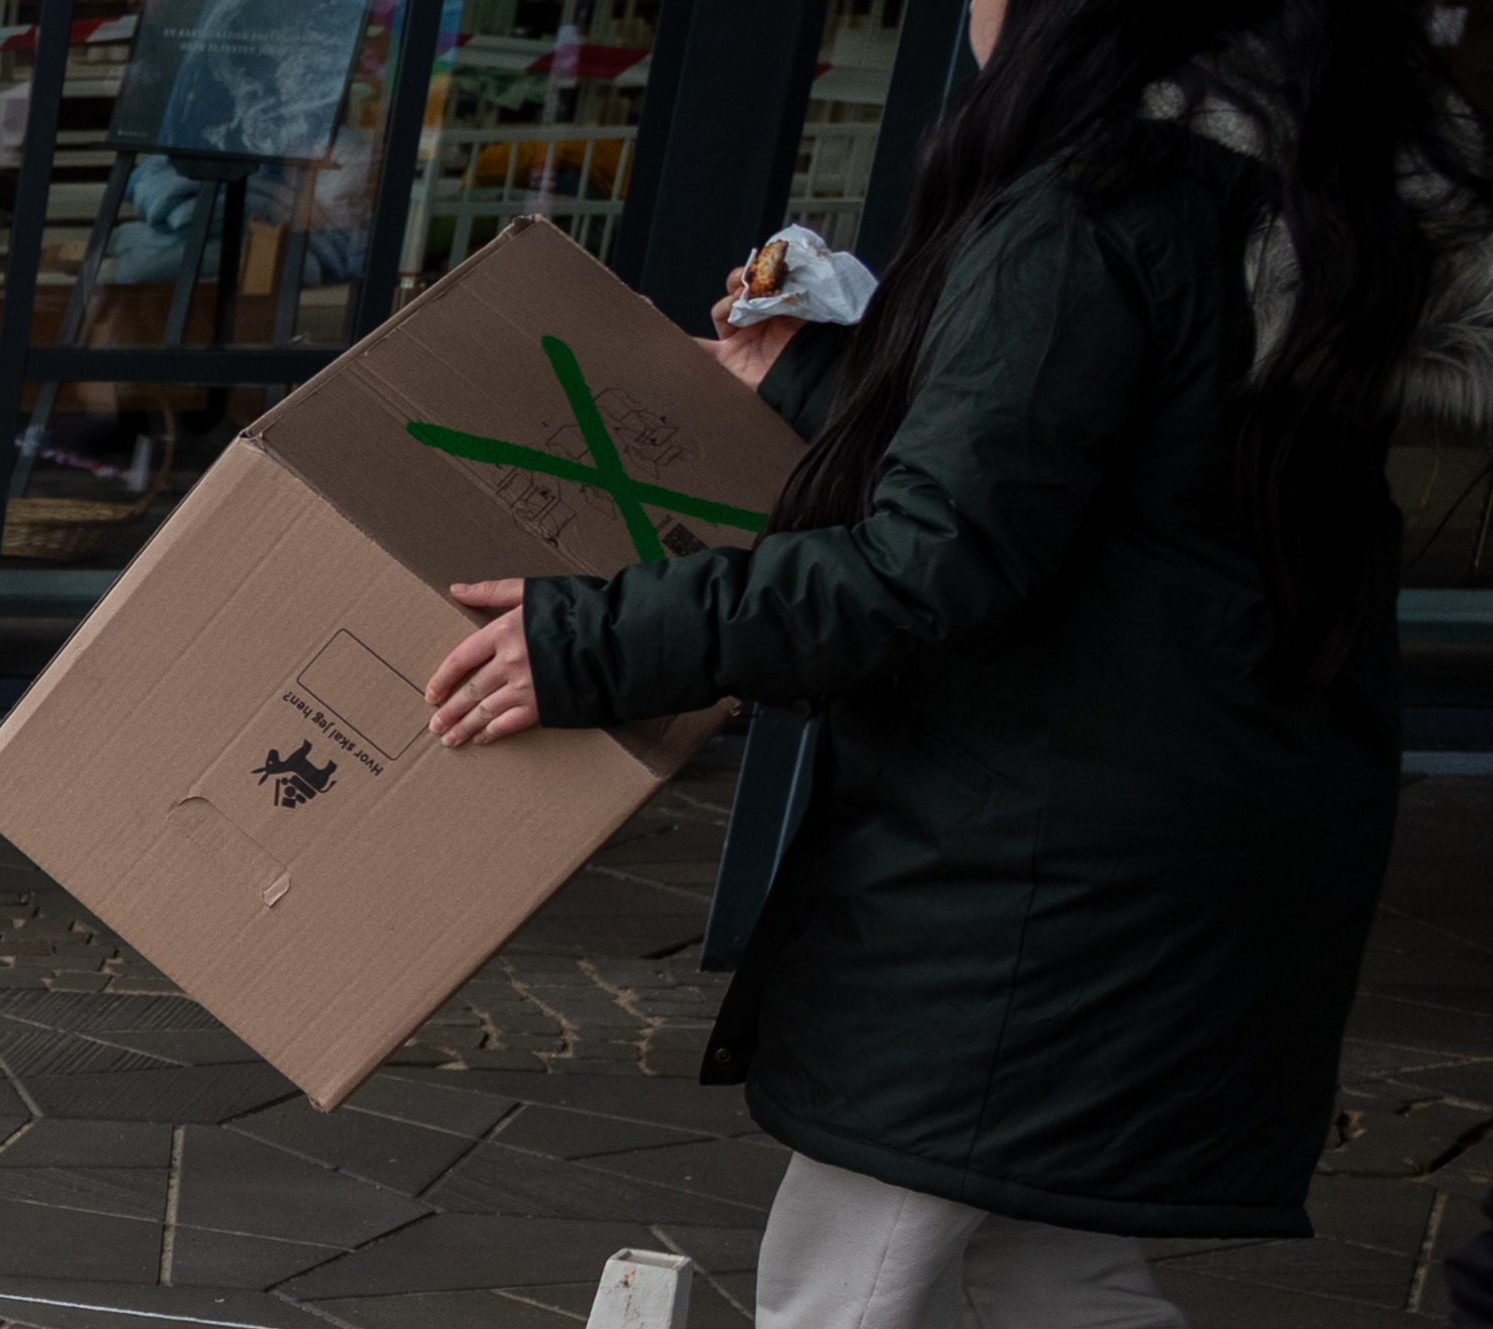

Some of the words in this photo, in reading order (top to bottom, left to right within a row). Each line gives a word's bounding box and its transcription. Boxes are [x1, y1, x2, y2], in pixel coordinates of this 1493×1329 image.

[282, 691, 314, 719] hen?
[311, 711, 335, 734] jeg
[328, 728, 357, 752] skal
[353, 747, 385, 777] Hvor
